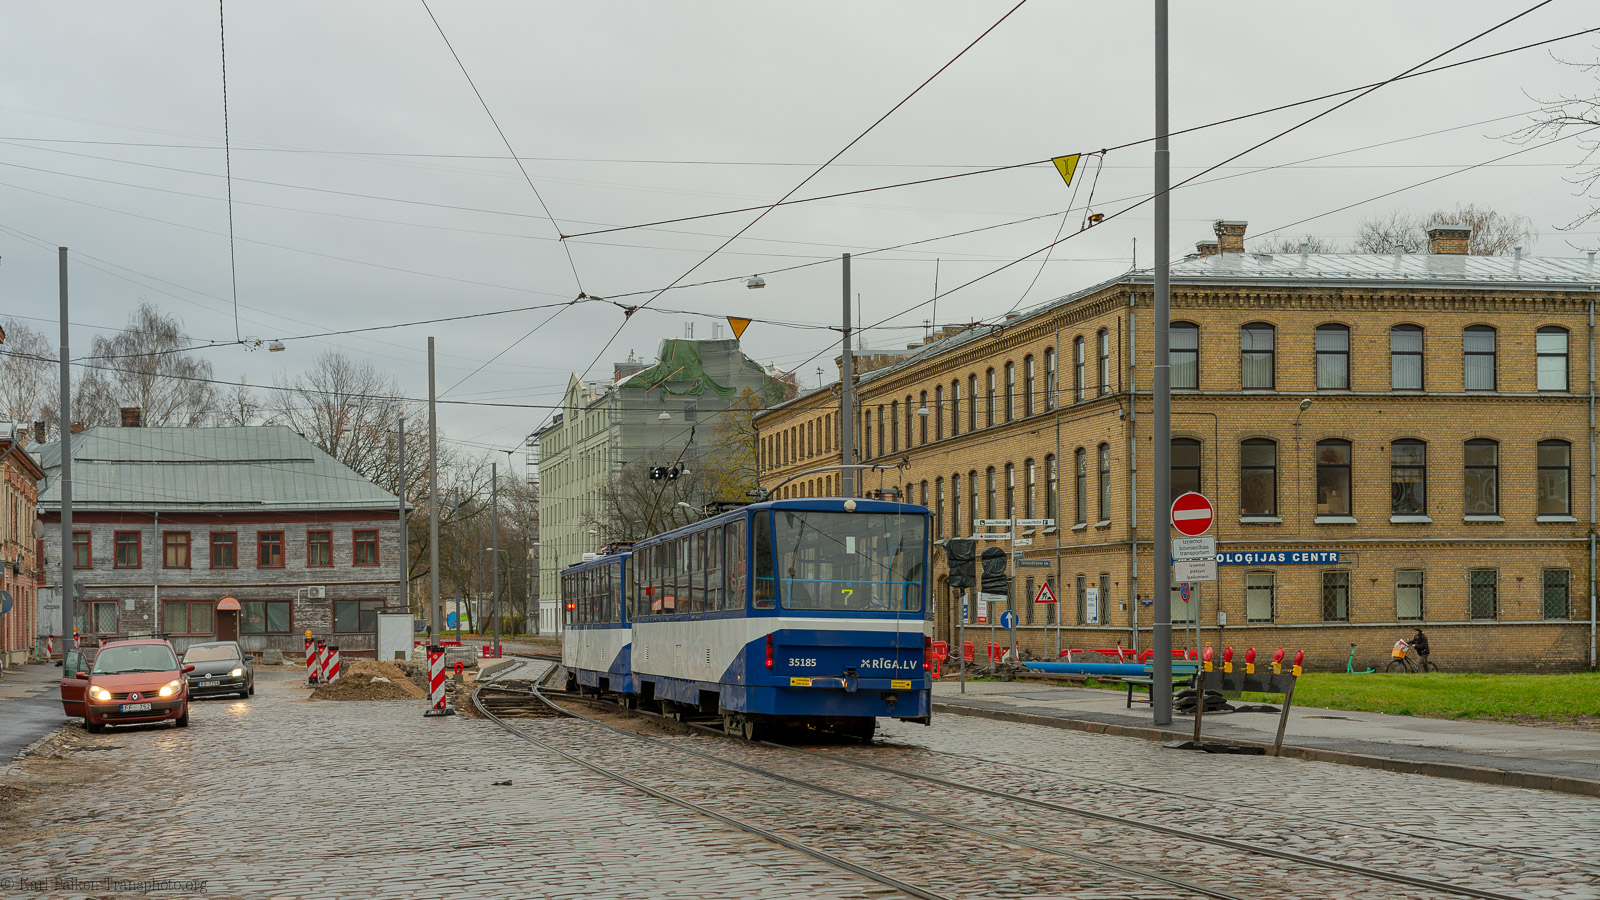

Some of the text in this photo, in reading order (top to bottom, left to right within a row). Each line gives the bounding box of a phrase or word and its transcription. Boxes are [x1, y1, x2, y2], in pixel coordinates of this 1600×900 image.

[841, 589, 853, 606] 7
[788, 658, 817, 667] 35185
[872, 658, 917, 669] RĪGA.LV
